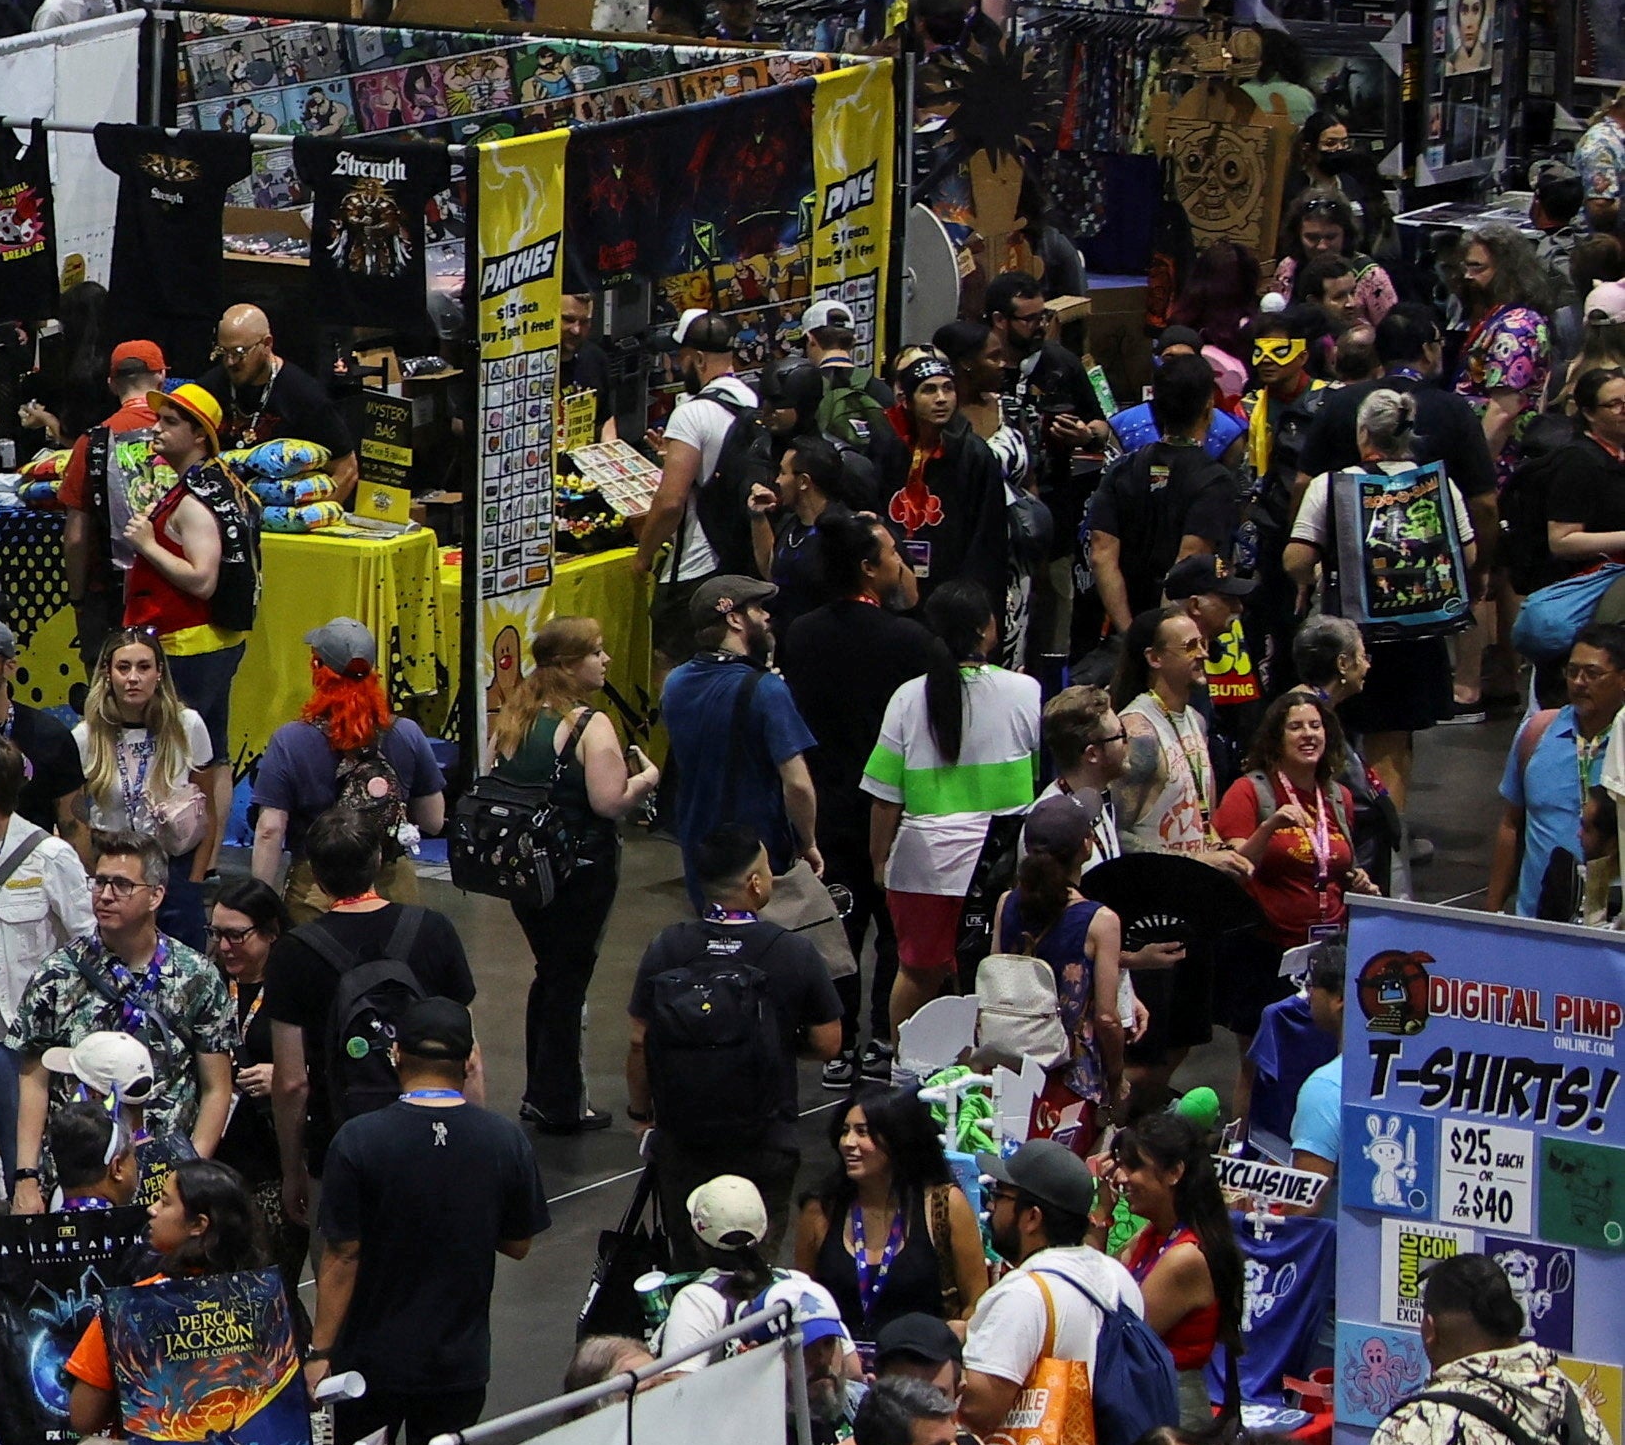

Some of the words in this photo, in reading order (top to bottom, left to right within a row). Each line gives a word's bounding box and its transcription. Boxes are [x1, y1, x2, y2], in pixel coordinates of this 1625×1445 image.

[331, 150, 408, 186] Strength
[150, 187, 184, 206] Strength
[481, 240, 555, 296] PATCHES
[496, 304, 517, 321] $15
[517, 299, 540, 317] each
[366, 399, 412, 422] MYSTERY
[374, 421, 397, 441] BAG
[1428, 974, 1549, 1032] DIGITAL
[1553, 992, 1624, 1041] PIMP
[1553, 1036, 1616, 1058] ONLINE.COM
[1368, 1039, 1622, 1135] T-SHIRTS!
[1450, 1128, 1492, 1167] $25
[1496, 1151, 1525, 1170] EACH
[1479, 1170, 1495, 1183] OR
[1458, 1181, 1471, 1200] 2
[1451, 1203, 1470, 1218] FOR
[1471, 1187, 1514, 1225] $40
[31, 1257, 74, 1265] ORIGINAL
[79, 1252, 114, 1263] SERIES
[1420, 1238, 1459, 1261] CON
[1398, 1232, 1422, 1299] COMIC
[177, 1310, 251, 1335] PERCY
[164, 1321, 255, 1352] JACKSON
[168, 1348, 189, 1361] AND
[193, 1345, 211, 1357] THE
